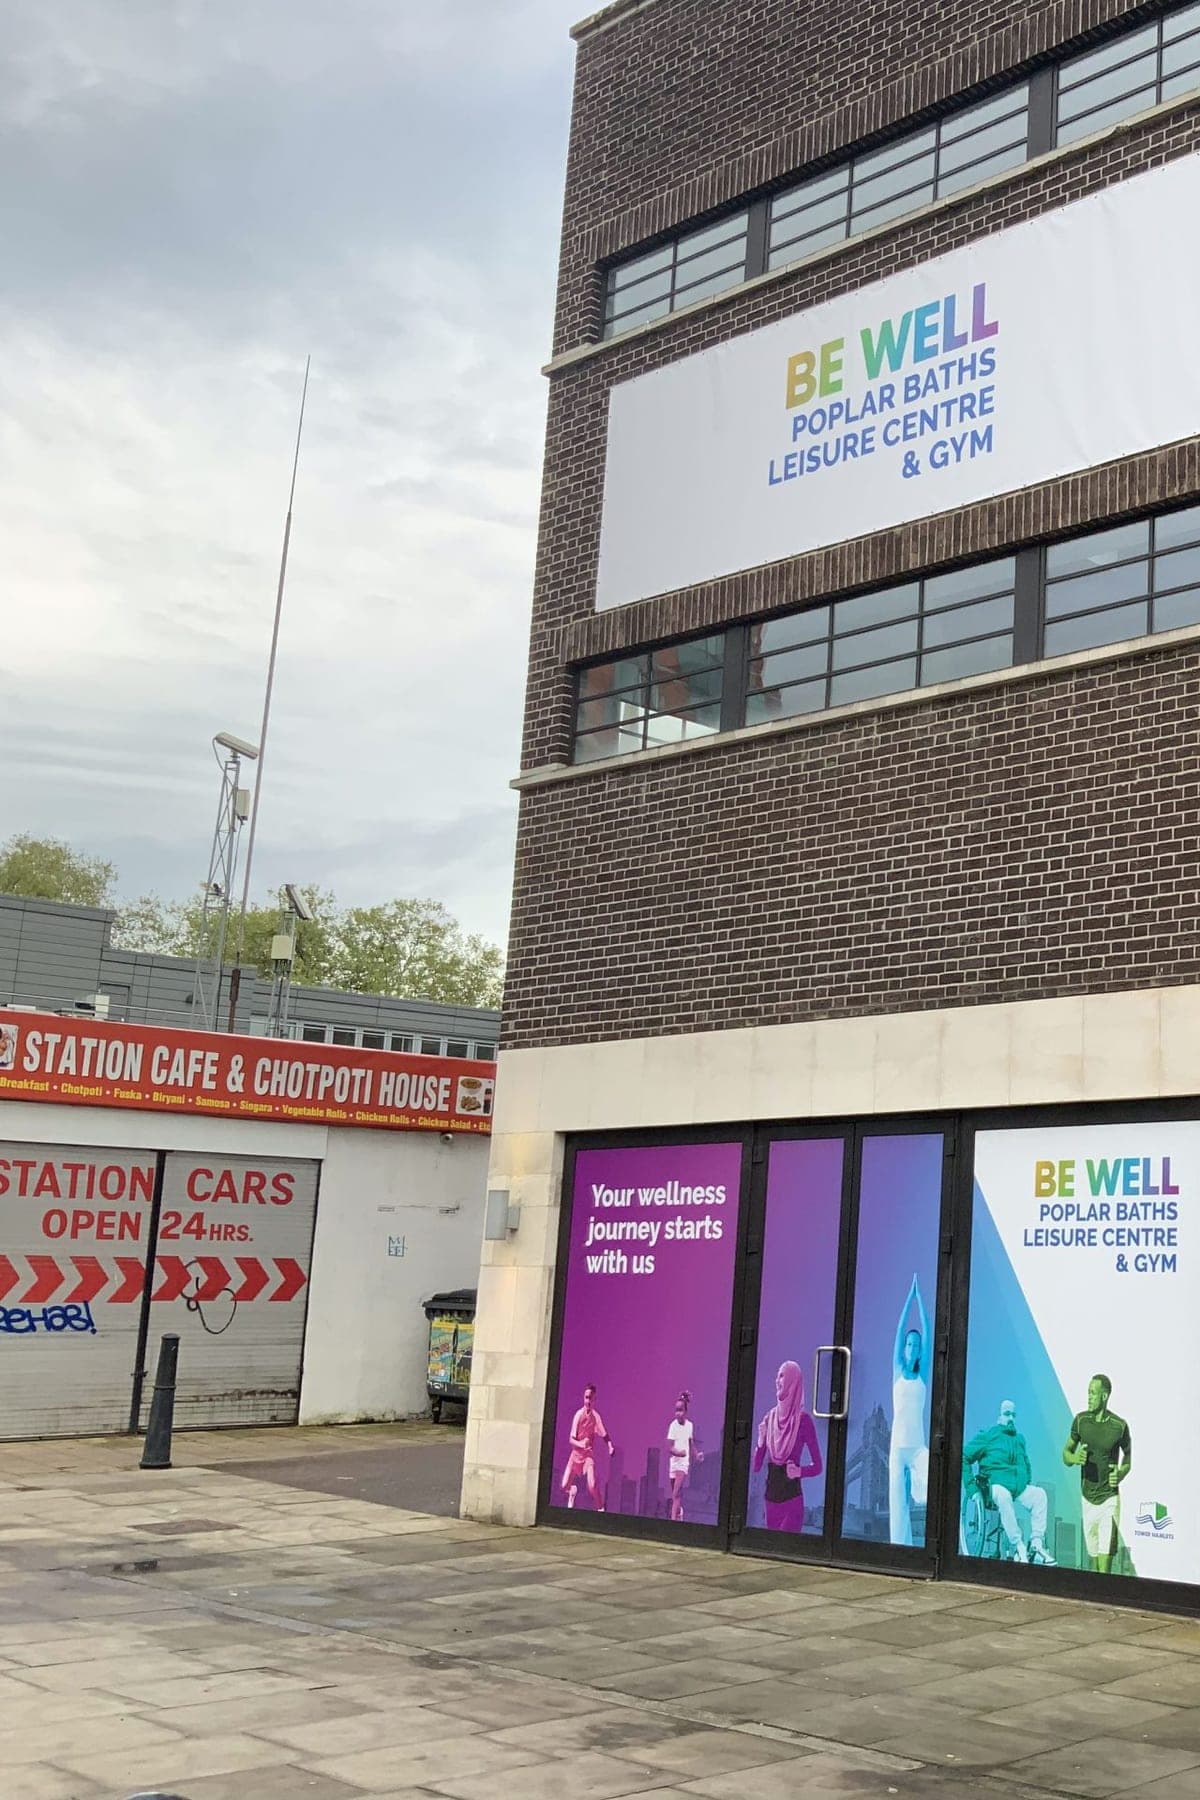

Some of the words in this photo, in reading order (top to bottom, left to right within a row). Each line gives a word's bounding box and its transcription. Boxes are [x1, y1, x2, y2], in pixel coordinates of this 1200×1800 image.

[786, 337, 844, 410] BE
[860, 282, 999, 380] WELL
[792, 383, 896, 442] POPLAR
[903, 347, 996, 404] BATHS
[768, 426, 876, 486] LEISURE
[882, 384, 995, 447] CENTRE
[902, 450, 921, 479] &
[929, 424, 993, 468] GYM
[23, 1030, 144, 1082] STATION
[150, 1045, 219, 1090] CAFE
[226, 1054, 245, 1093] &
[254, 1057, 373, 1105] CHOTPOTI
[378, 1071, 451, 1112] HOUSE
[0, 1077, 50, 1091] Breakfast
[61, 1083, 102, 1096] Chotpoti
[114, 1088, 142, 1100] Fuska
[152, 1092, 186, 1105] Biryani
[196, 1096, 230, 1109] Samosa
[282, 1105, 324, 1117] Vegetable
[326, 1108, 347, 1119] Rolls
[356, 1111, 388, 1122] Chicken
[390, 1114, 410, 1124] Rolls
[418, 1116, 449, 1127] Chicken
[450, 1119, 471, 1129] Salad
[187, 1168, 295, 1205] CARS
[592, 1184, 634, 1207] Your
[638, 1180, 726, 1206] wellness
[1035, 1160, 1075, 1197] BE
[1086, 1157, 1179, 1196] WELL
[42, 1209, 142, 1240] OPEN
[585, 1216, 661, 1246] journey
[664, 1215, 723, 1239] starts
[1040, 1203, 1110, 1222] POPLAR
[1116, 1202, 1178, 1221] BATHS
[1024, 1228, 1097, 1246] LEISURE
[1102, 1228, 1178, 1246] CENTRE
[586, 1249, 627, 1274] with
[632, 1254, 655, 1274] us
[1116, 1254, 1129, 1272] &
[1134, 1254, 1176, 1272] GYM
